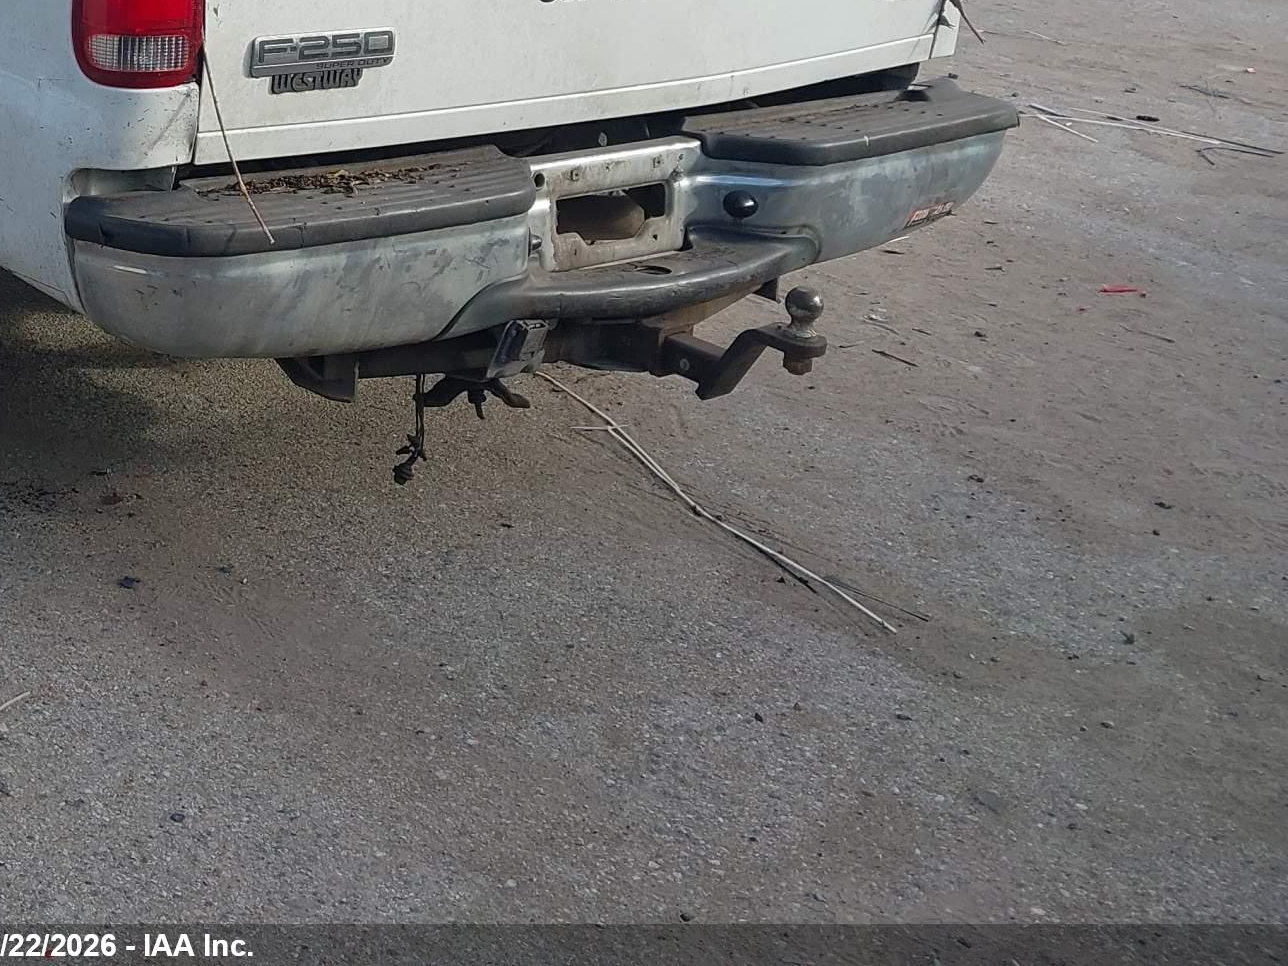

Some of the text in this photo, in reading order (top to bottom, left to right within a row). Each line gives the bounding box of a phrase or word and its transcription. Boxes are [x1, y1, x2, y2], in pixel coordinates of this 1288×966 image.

[315, 57, 390, 70] SUPER DUTY
[272, 68, 363, 94] WESTWAY
